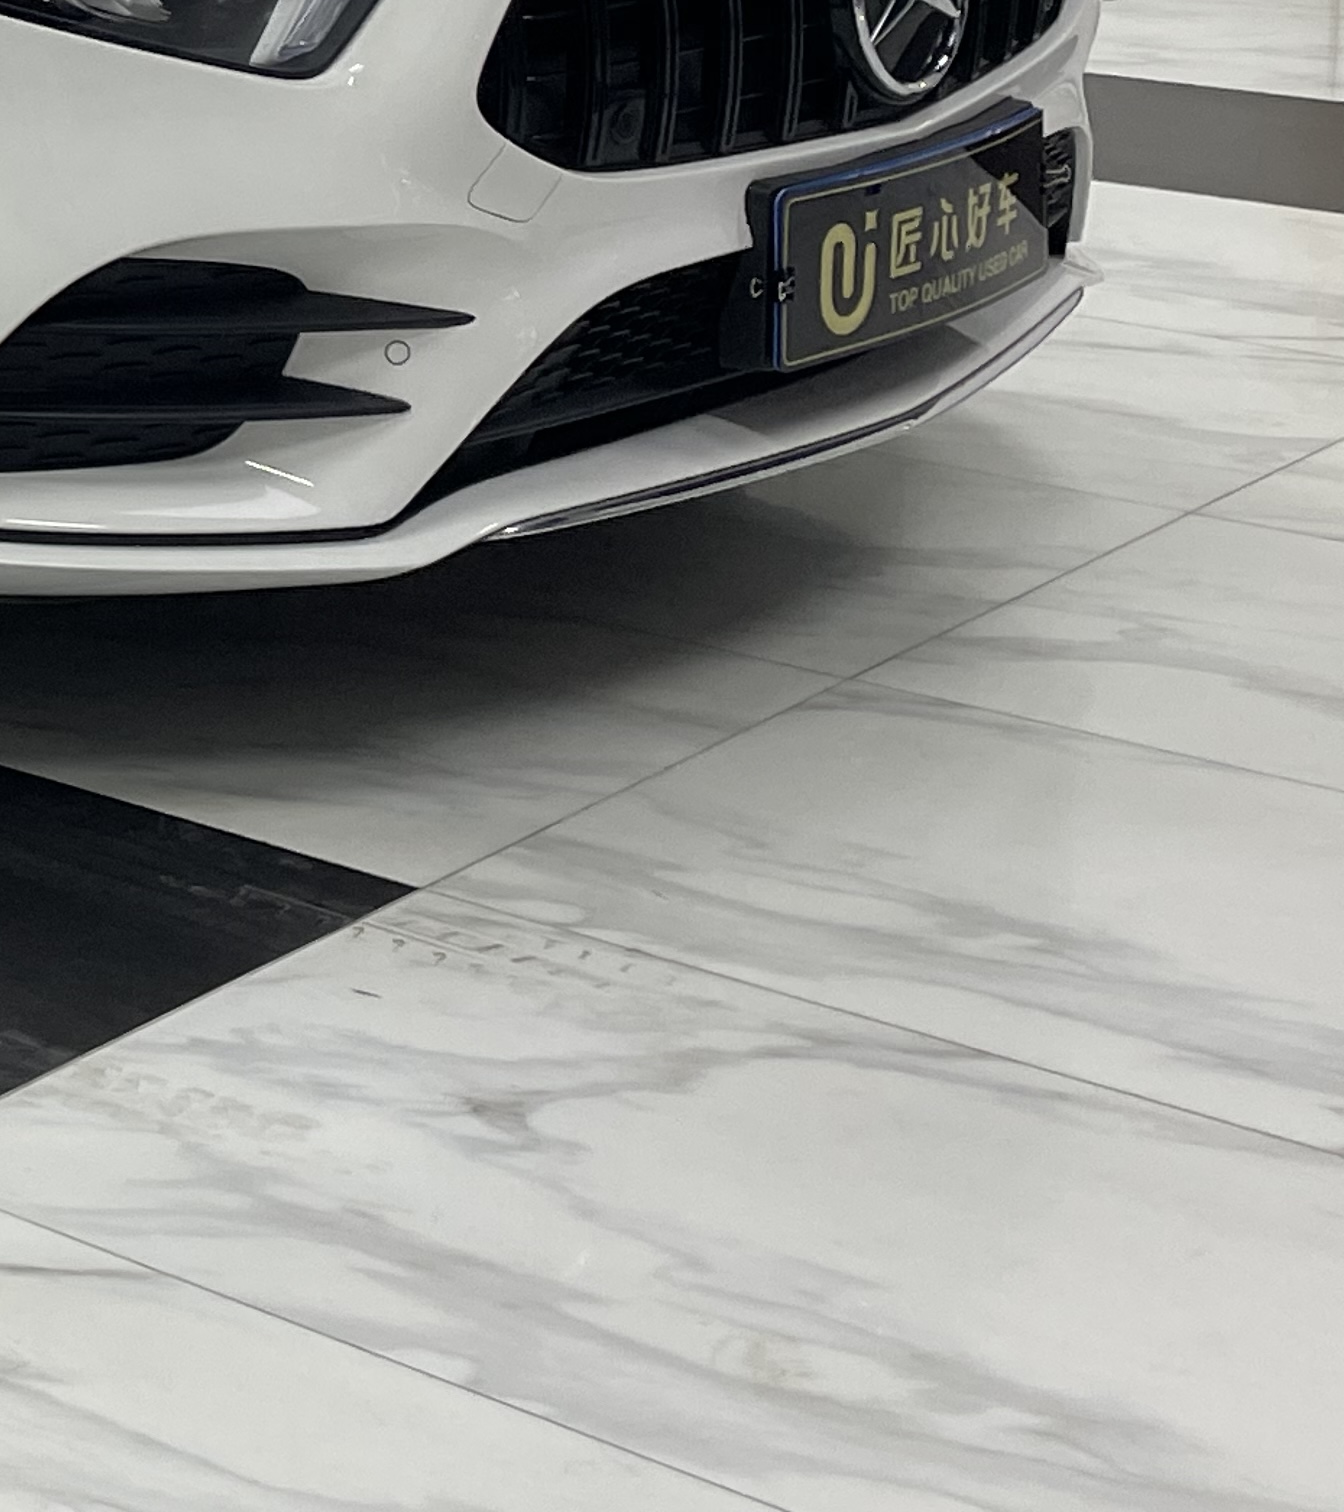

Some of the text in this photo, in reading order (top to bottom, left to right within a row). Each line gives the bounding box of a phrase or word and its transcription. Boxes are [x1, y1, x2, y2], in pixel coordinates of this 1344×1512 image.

[889, 172, 1020, 280] 匠心好车
[889, 239, 1029, 315] TOP QUALITY USED CAR
